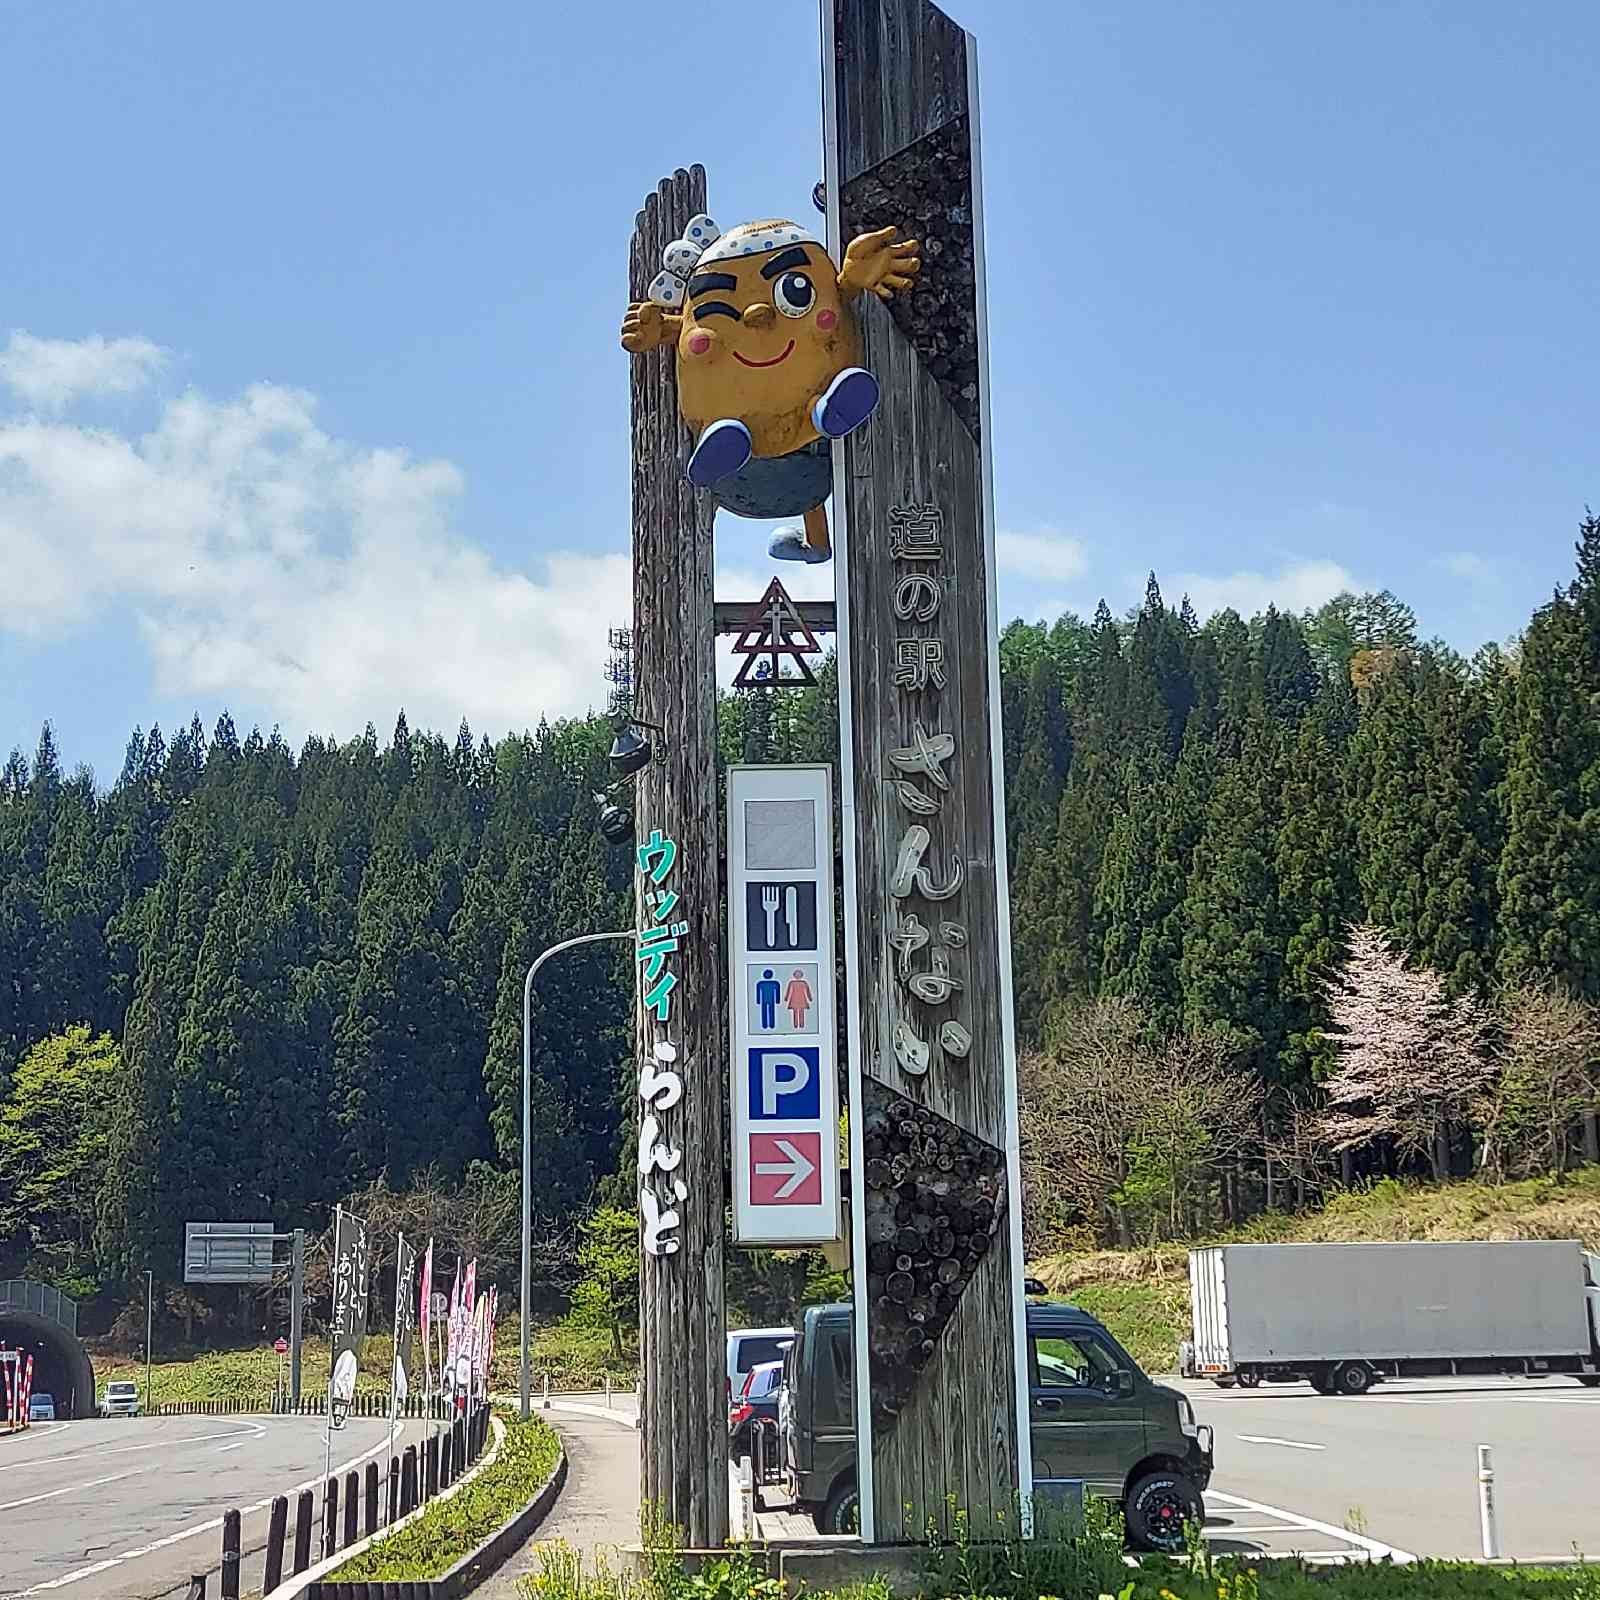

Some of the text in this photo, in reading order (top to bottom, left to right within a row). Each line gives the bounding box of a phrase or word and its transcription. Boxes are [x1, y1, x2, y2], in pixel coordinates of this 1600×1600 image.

[888, 502, 948, 692] 道の駅
[636, 828, 688, 1021] ウッディ
[888, 718, 973, 1075] さんない
[638, 1041, 688, 1256] らんど
[761, 1053, 810, 1115] P
